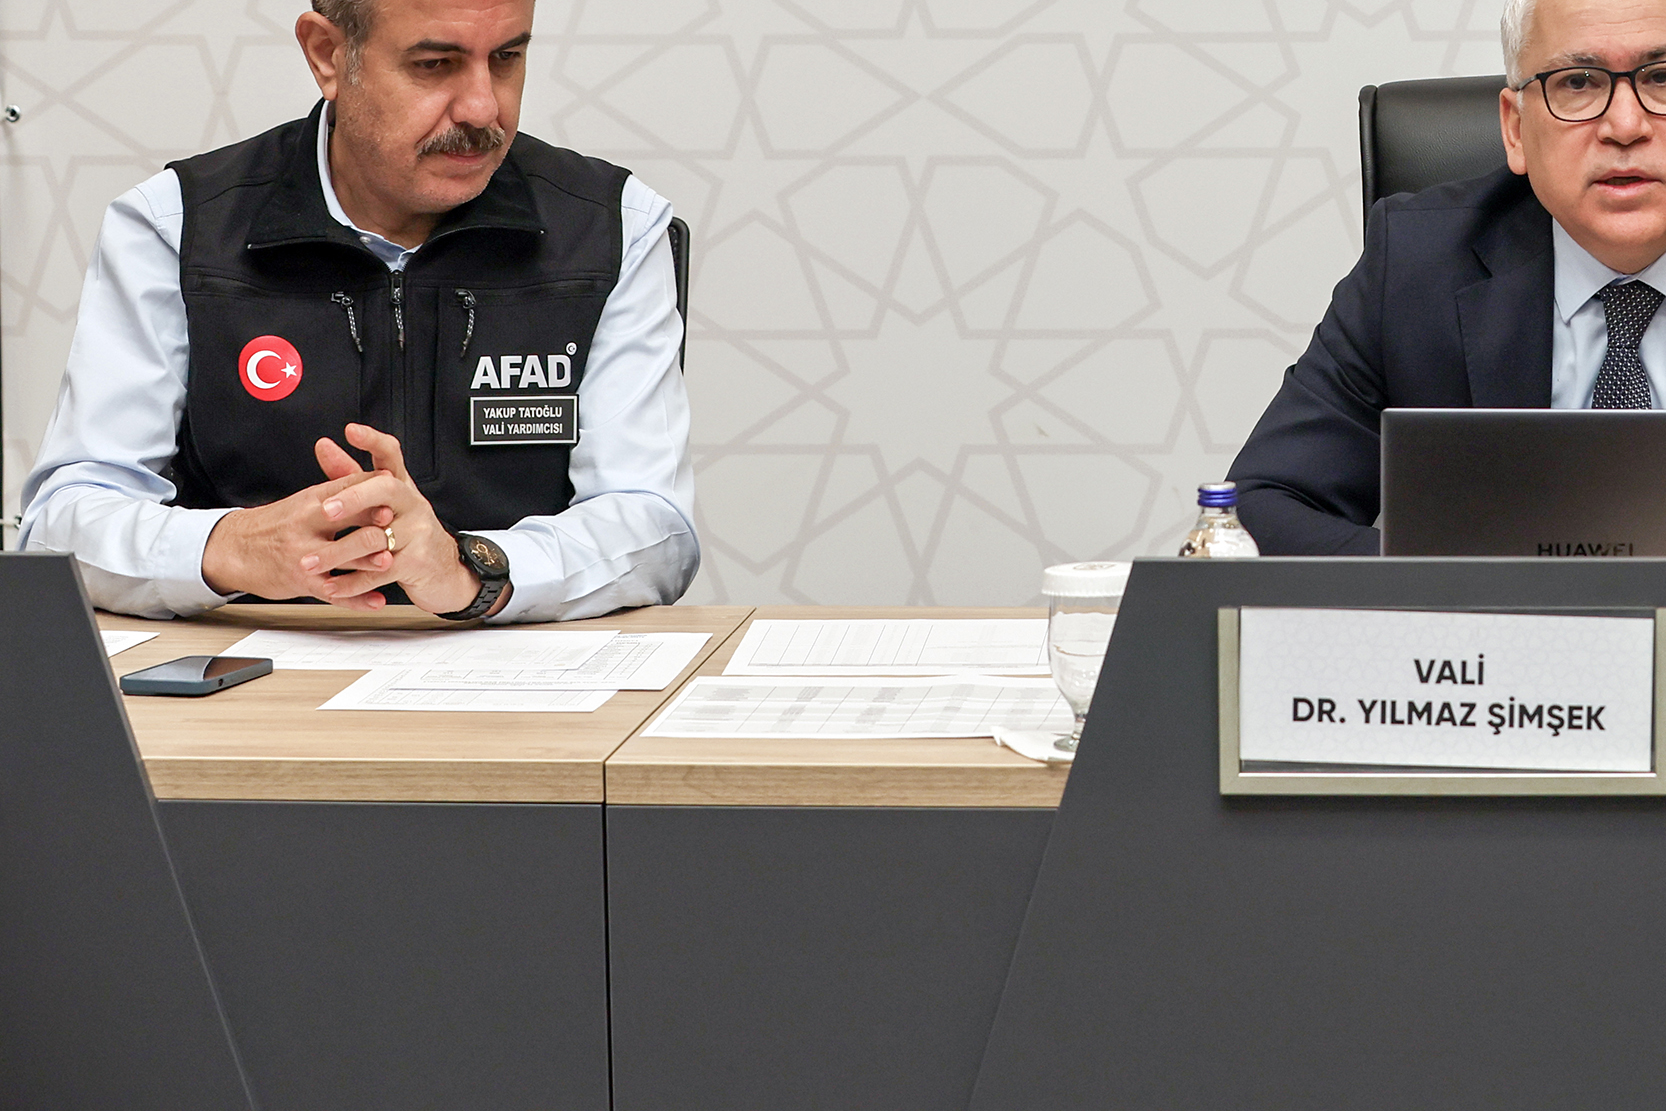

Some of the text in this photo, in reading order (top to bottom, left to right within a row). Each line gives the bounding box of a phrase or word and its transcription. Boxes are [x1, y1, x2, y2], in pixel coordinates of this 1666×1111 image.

[470, 354, 572, 389] AFAD
[483, 404, 563, 419] YAKUP TATOĞLU
[482, 421, 563, 435] VALİ YARDIMCISI
[1414, 653, 1485, 685] VALİ
[1292, 697, 1605, 736] DR. YILMAZ ŞİMŞEK
